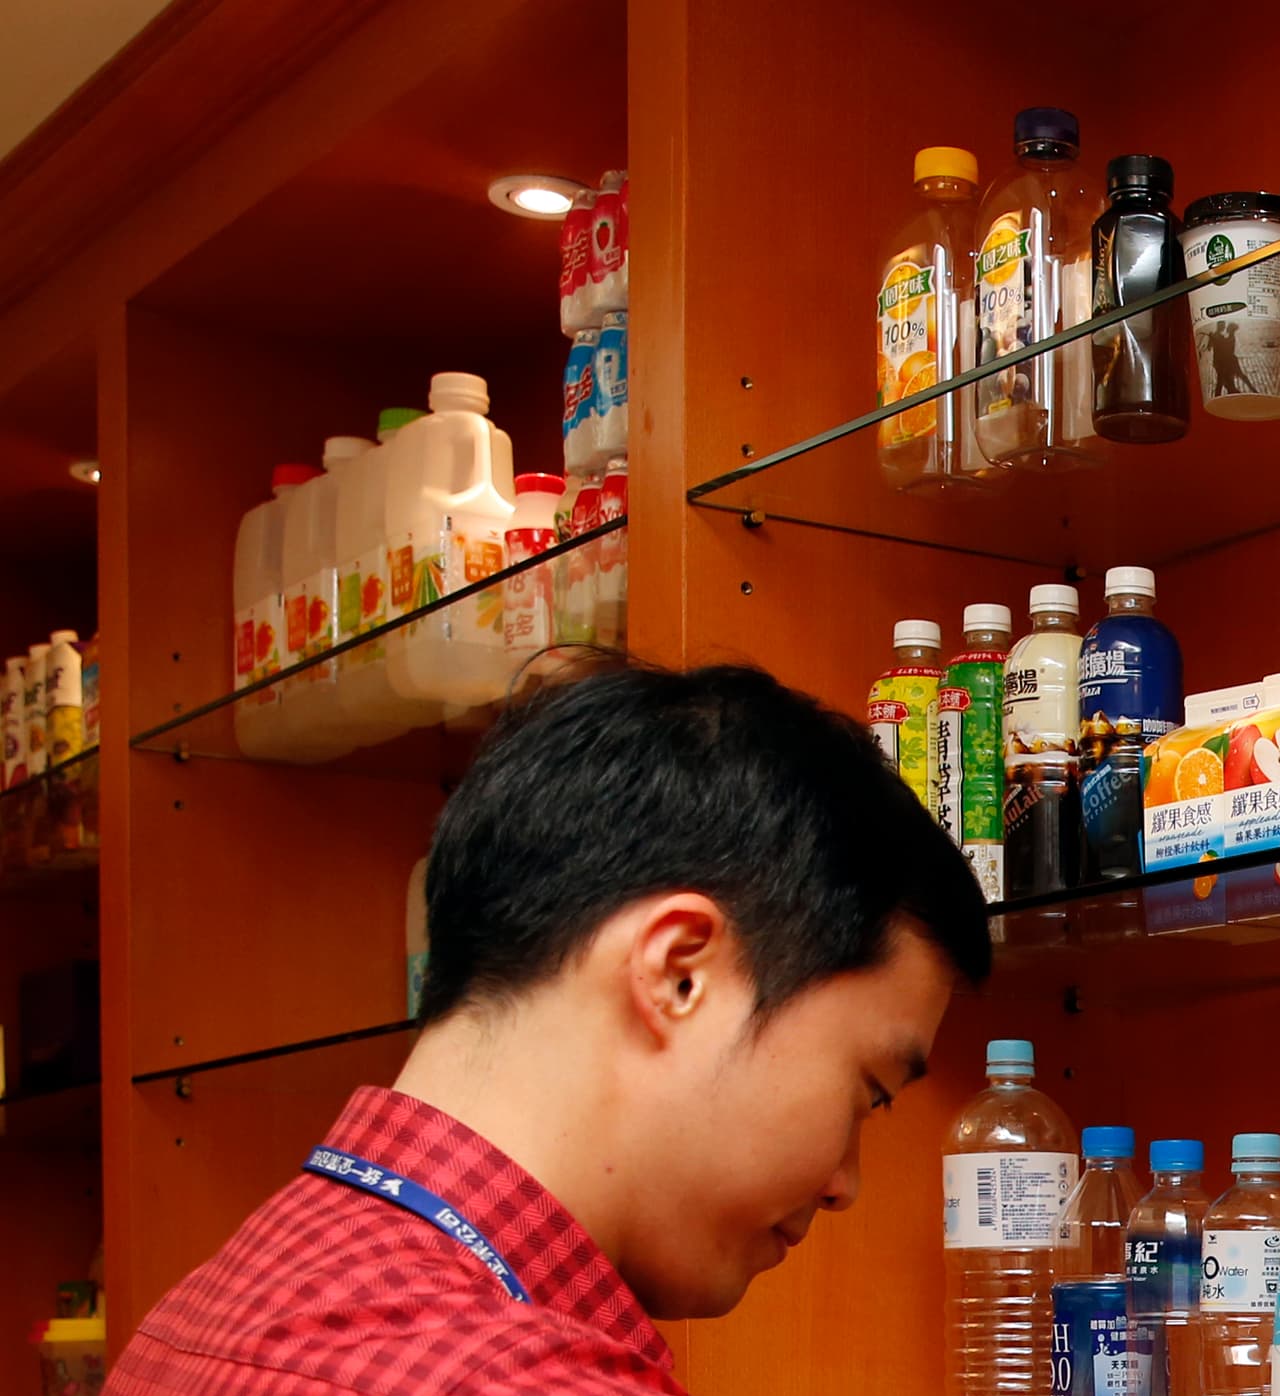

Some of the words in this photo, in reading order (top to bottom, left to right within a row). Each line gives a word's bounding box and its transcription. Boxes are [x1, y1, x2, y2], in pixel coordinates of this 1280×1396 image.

[982, 286, 1022, 314] 100%
[884, 319, 925, 346] 100%
[1081, 771, 1133, 818] Coffee
[1151, 802, 1213, 834] 纖果食感
[434, 1207, 525, 1302] 一企業公司
[1219, 1265, 1249, 1277] Water
